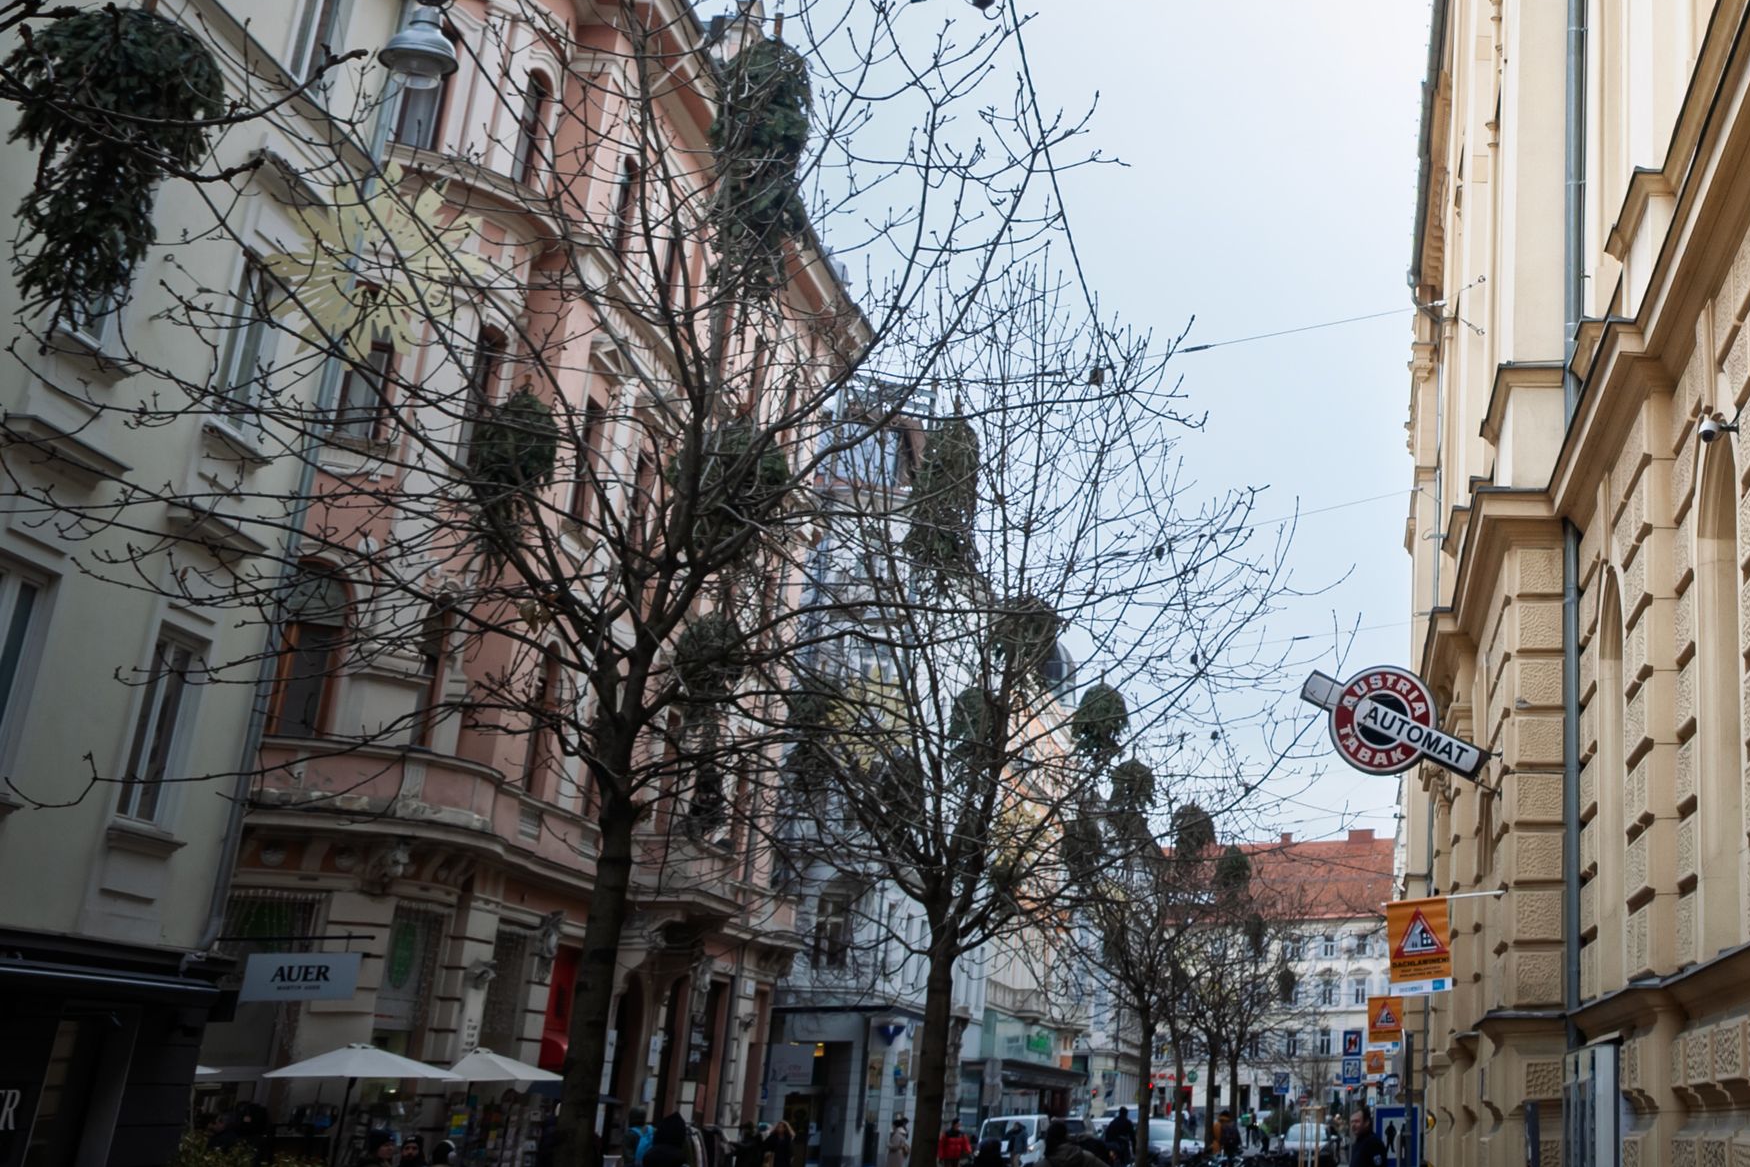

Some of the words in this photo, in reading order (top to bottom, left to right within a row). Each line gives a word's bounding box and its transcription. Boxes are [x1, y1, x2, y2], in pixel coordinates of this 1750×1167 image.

[1341, 674, 1427, 717] AUSTRIA
[1338, 723, 1406, 765] TABAK
[1362, 706, 1469, 765] AUTOMAT
[270, 965, 330, 983] AUER
[0, 1089, 21, 1131] R
